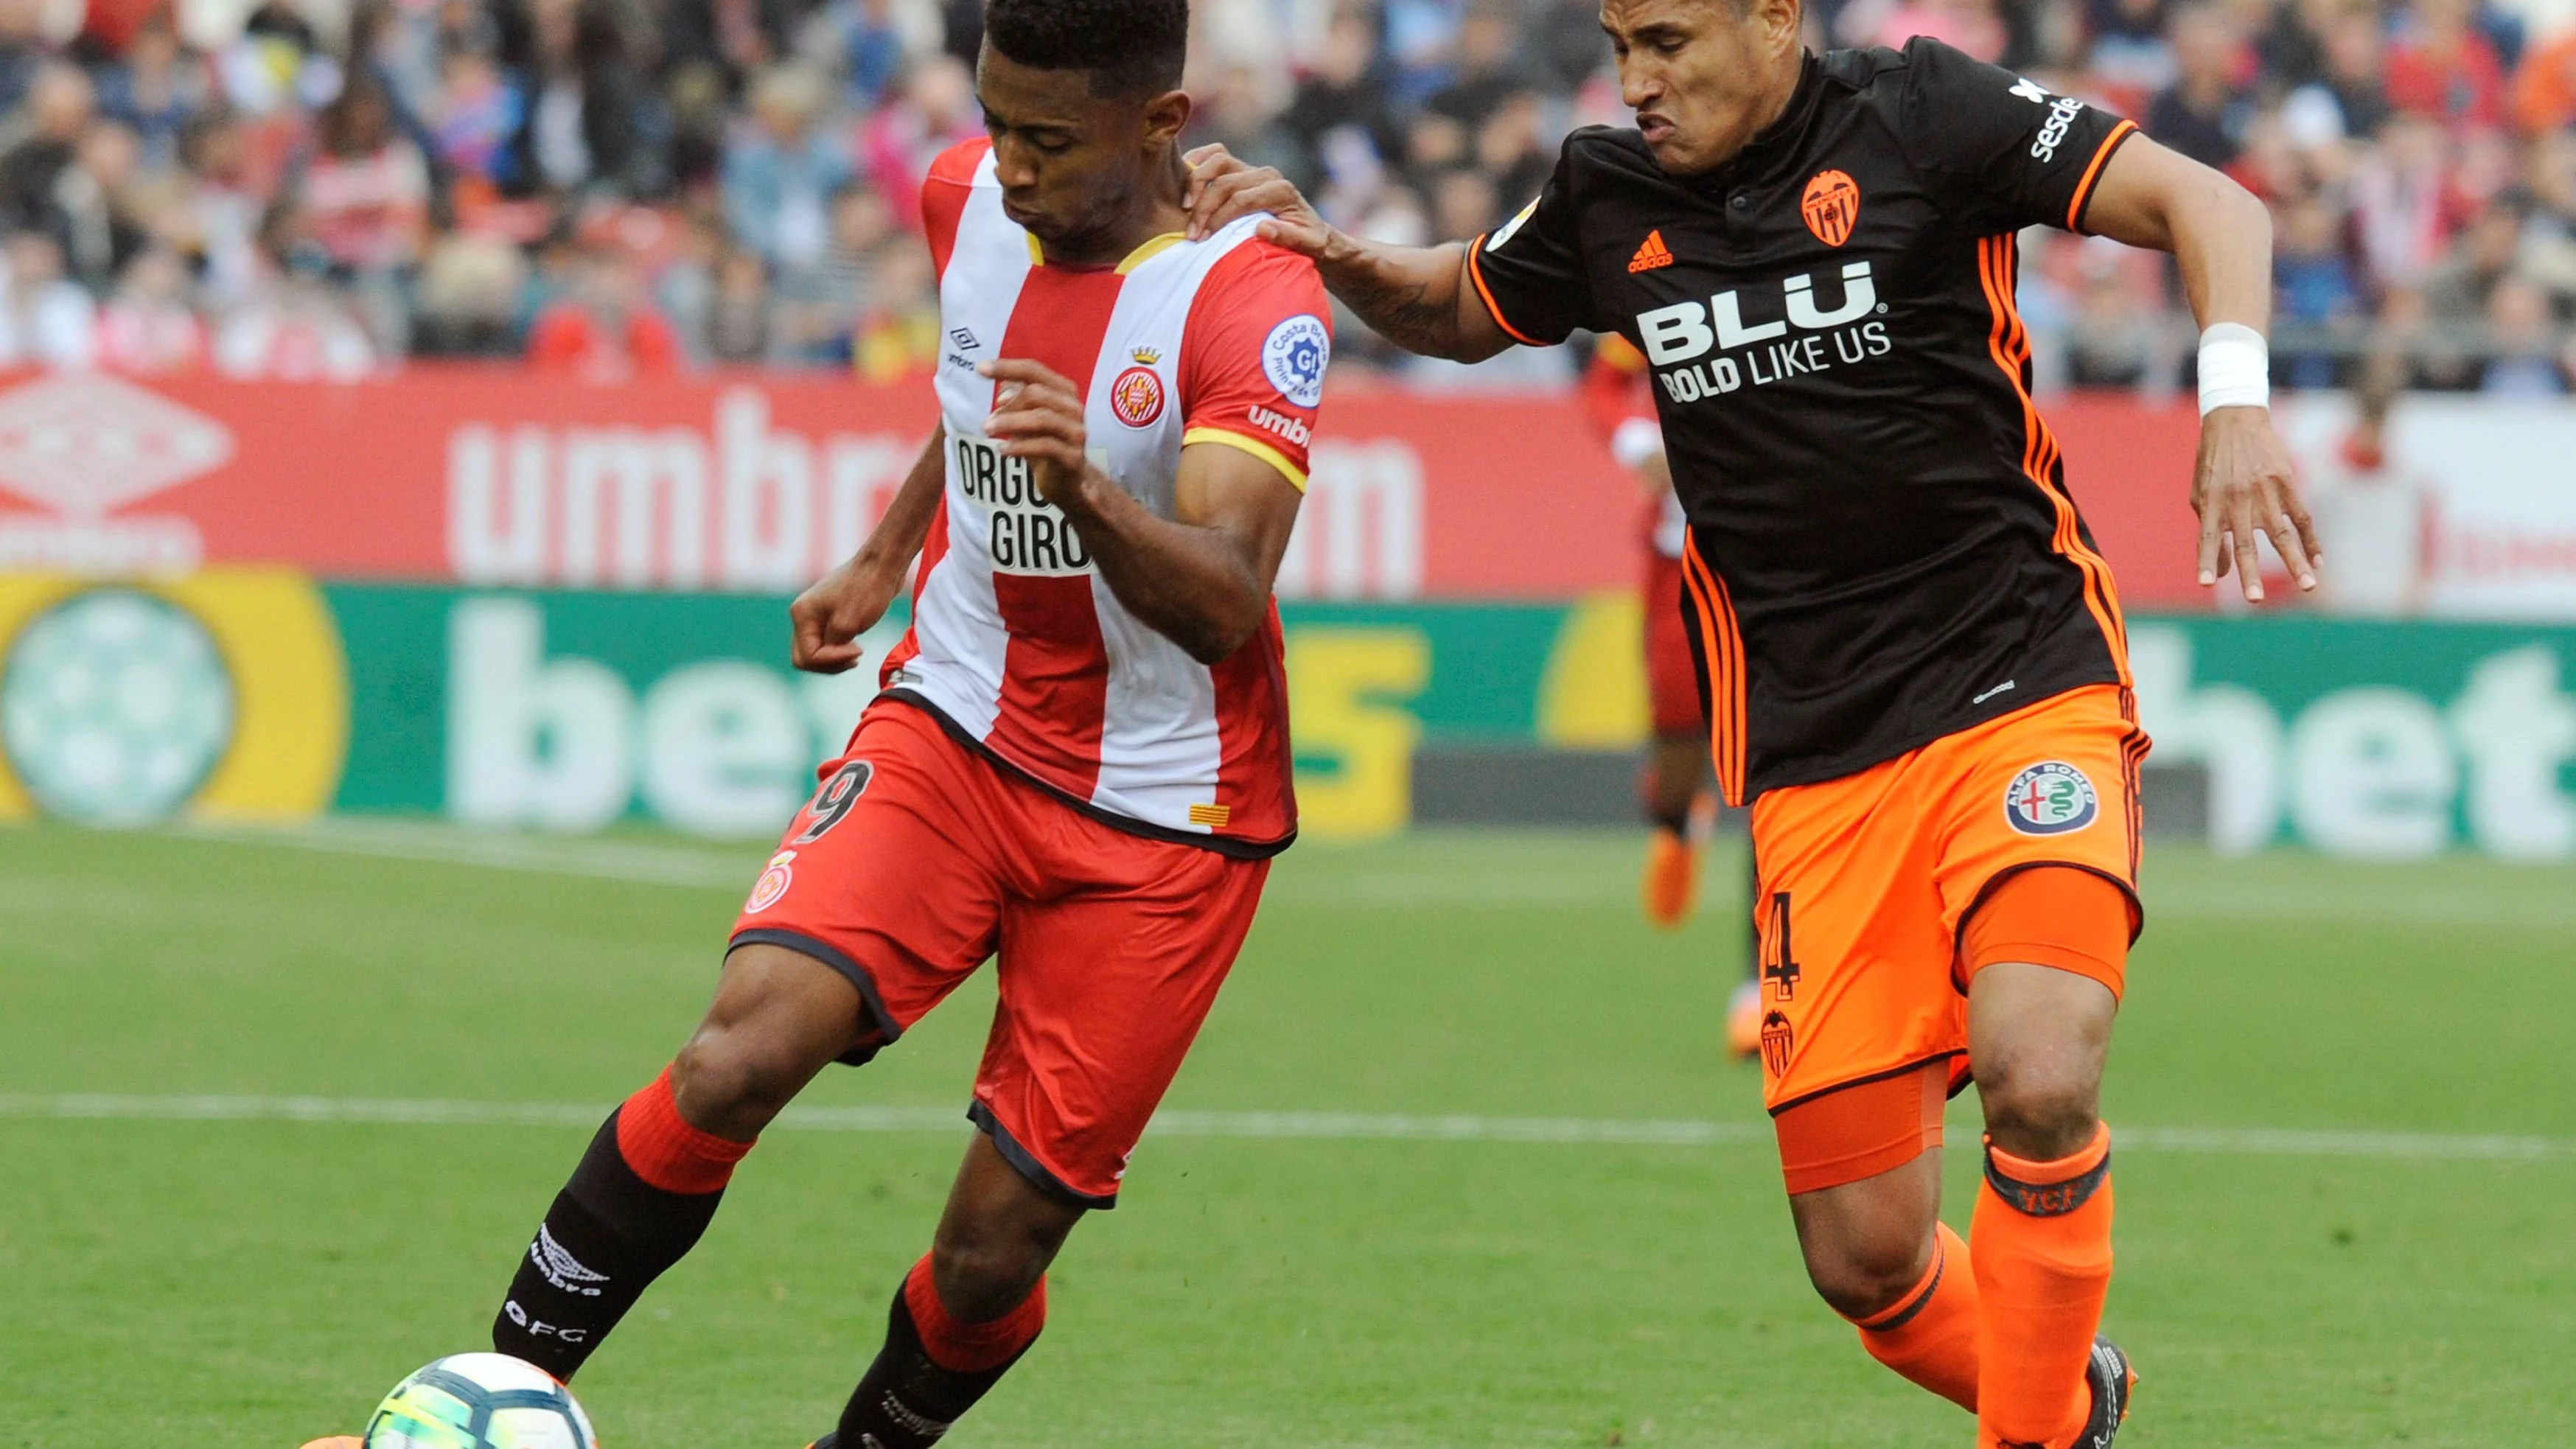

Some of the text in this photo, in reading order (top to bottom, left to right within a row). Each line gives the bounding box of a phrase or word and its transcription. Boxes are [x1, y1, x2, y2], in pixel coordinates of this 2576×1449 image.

[2031, 97, 2084, 163] sesde
[1627, 252, 1674, 273] adidas
[1273, 324, 1307, 351] Costa
[1659, 321, 1891, 403] BOLD LIKE US
[991, 510, 1092, 570] GIRO
[791, 759, 874, 845] 9
[2008, 764, 2095, 806] ALFA ROMEO
[1765, 892, 1801, 1002] 4
[531, 1241, 601, 1296] umbro
